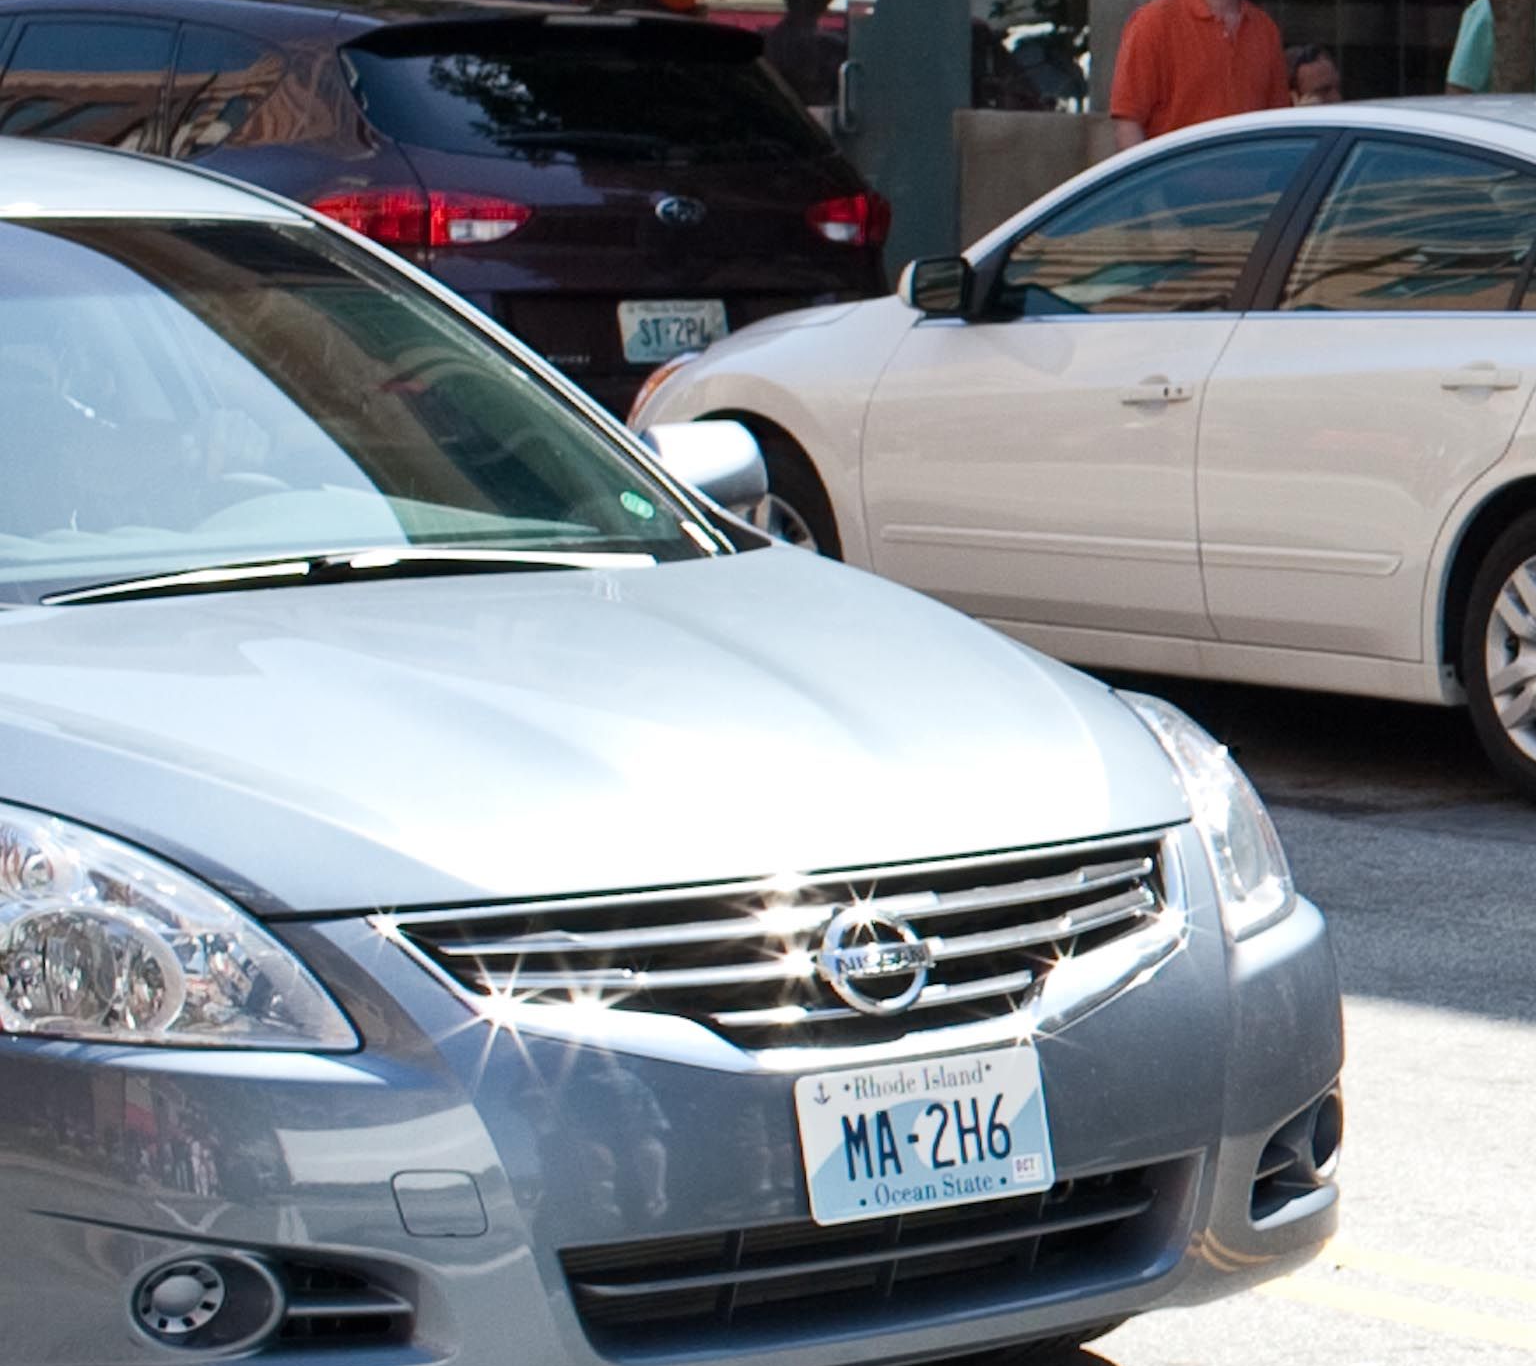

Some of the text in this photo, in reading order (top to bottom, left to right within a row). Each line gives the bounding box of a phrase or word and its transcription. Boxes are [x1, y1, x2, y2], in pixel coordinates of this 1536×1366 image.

[854, 1059, 984, 1101] Rhode Island
[841, 1093, 1012, 1181] MA-2H6
[874, 1174, 993, 1208] Ocean State
